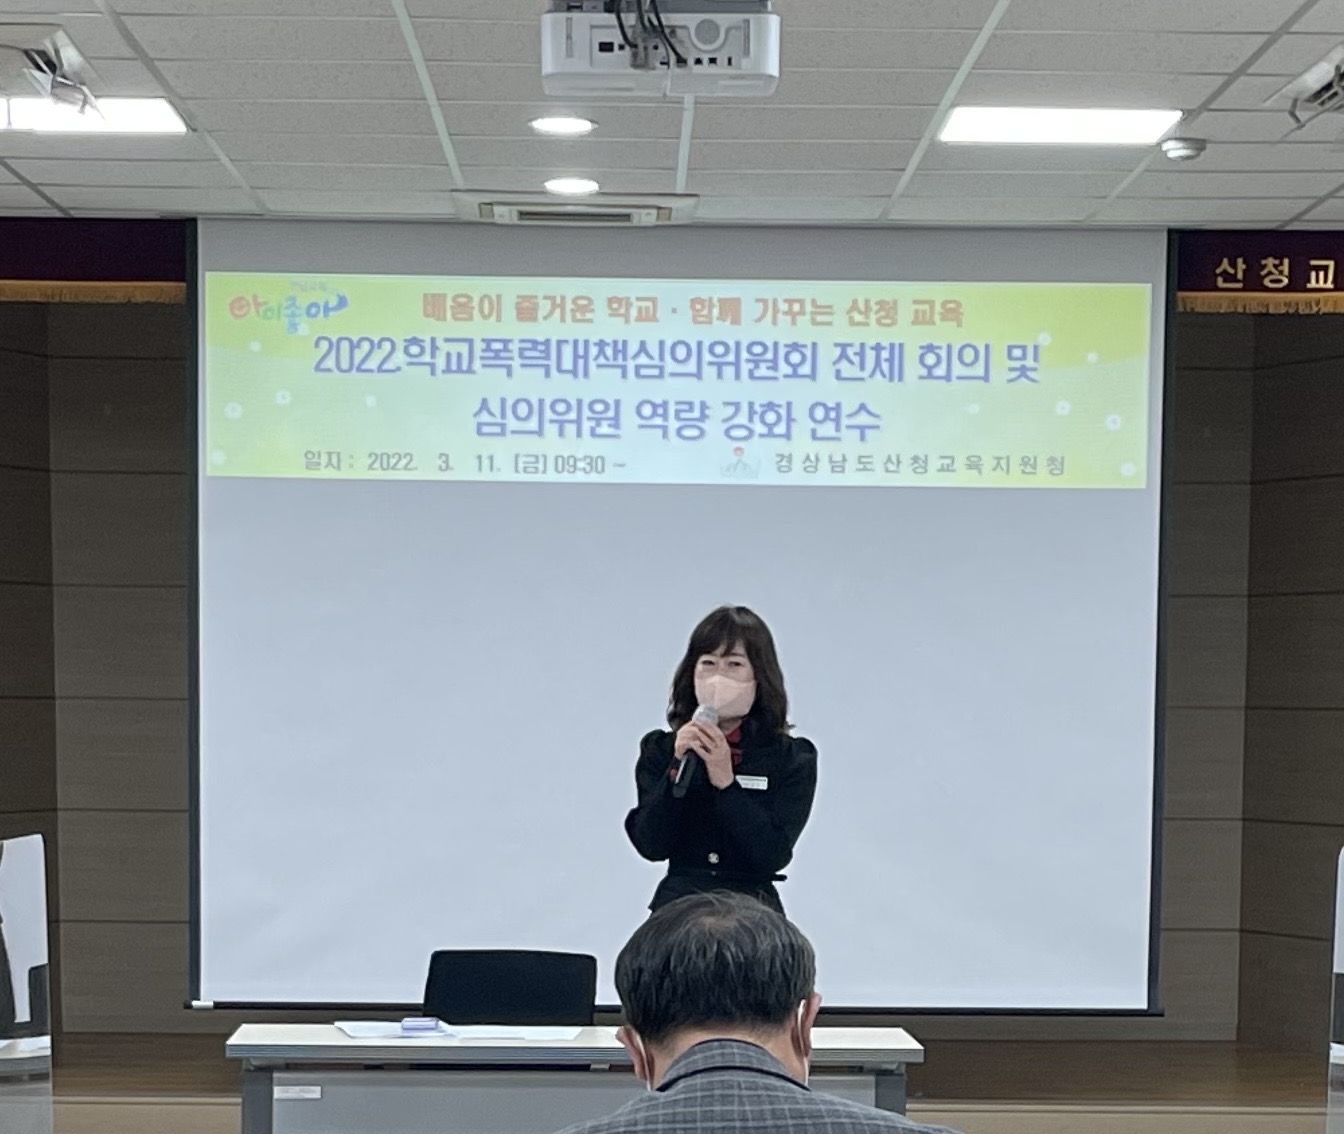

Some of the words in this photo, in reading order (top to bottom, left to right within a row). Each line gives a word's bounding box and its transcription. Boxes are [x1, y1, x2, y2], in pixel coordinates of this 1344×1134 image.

[423, 292, 503, 323] 배움이
[515, 294, 595, 324] 즐거운
[607, 295, 660, 325] 학교
[689, 296, 742, 326] 함께
[754, 296, 836, 328] 가꾸는
[846, 296, 899, 328] 산청
[910, 298, 964, 328] 교육
[832, 340, 905, 384] 전체
[917, 341, 991, 385] 회의
[1006, 342, 1041, 384] 및
[473, 396, 622, 439] 심의위원
[635, 398, 710, 441] 역량
[721, 399, 796, 442] 강화
[807, 400, 882, 443] 연수
